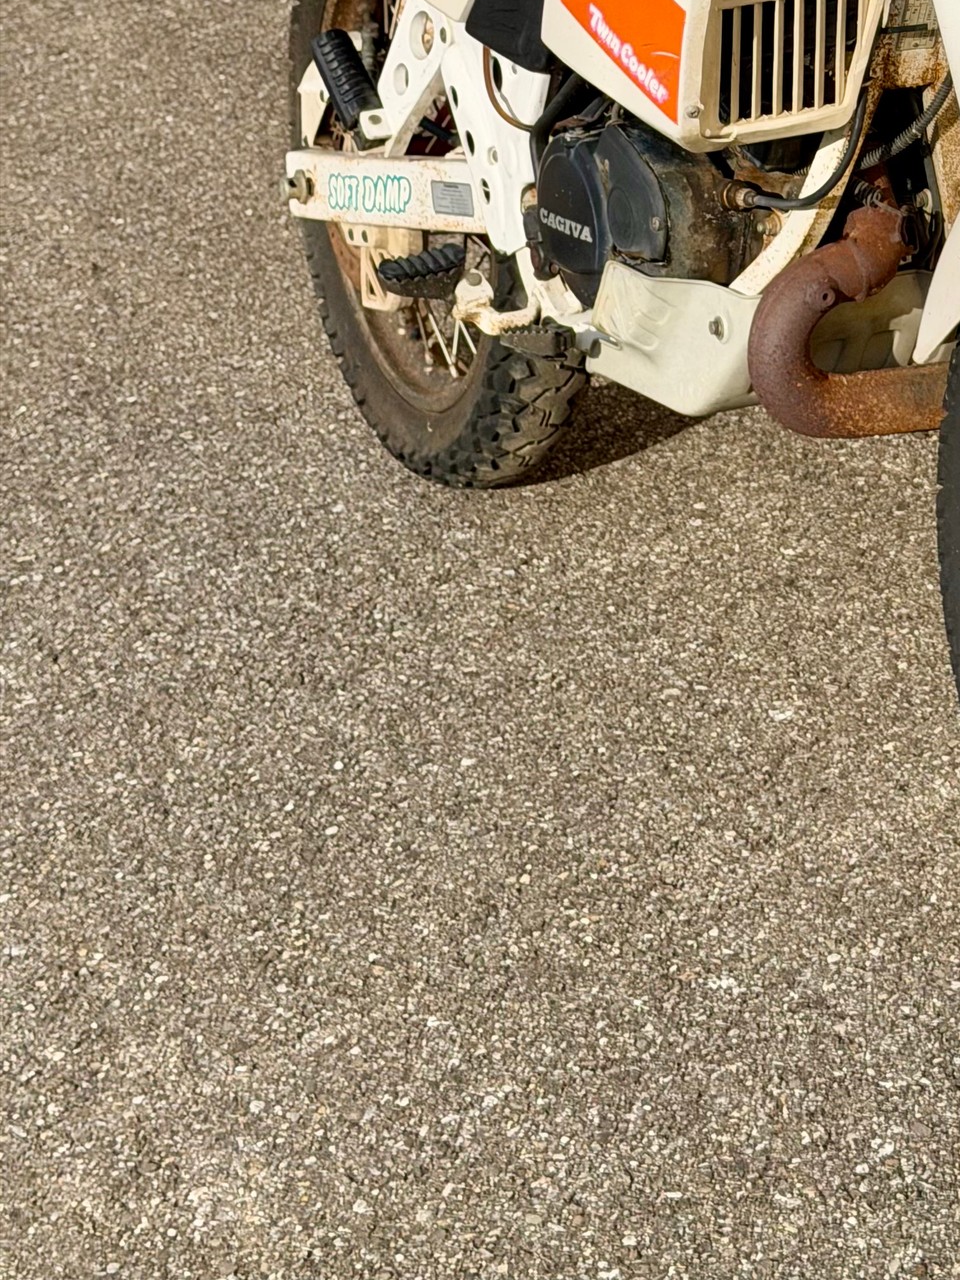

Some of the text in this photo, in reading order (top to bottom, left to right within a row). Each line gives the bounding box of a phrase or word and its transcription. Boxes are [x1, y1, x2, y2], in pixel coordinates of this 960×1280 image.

[588, 2, 669, 104] Twin Cooler
[328, 173, 360, 213] SOFT
[362, 175, 412, 214] DAMP
[540, 207, 593, 244] CAGIVA
